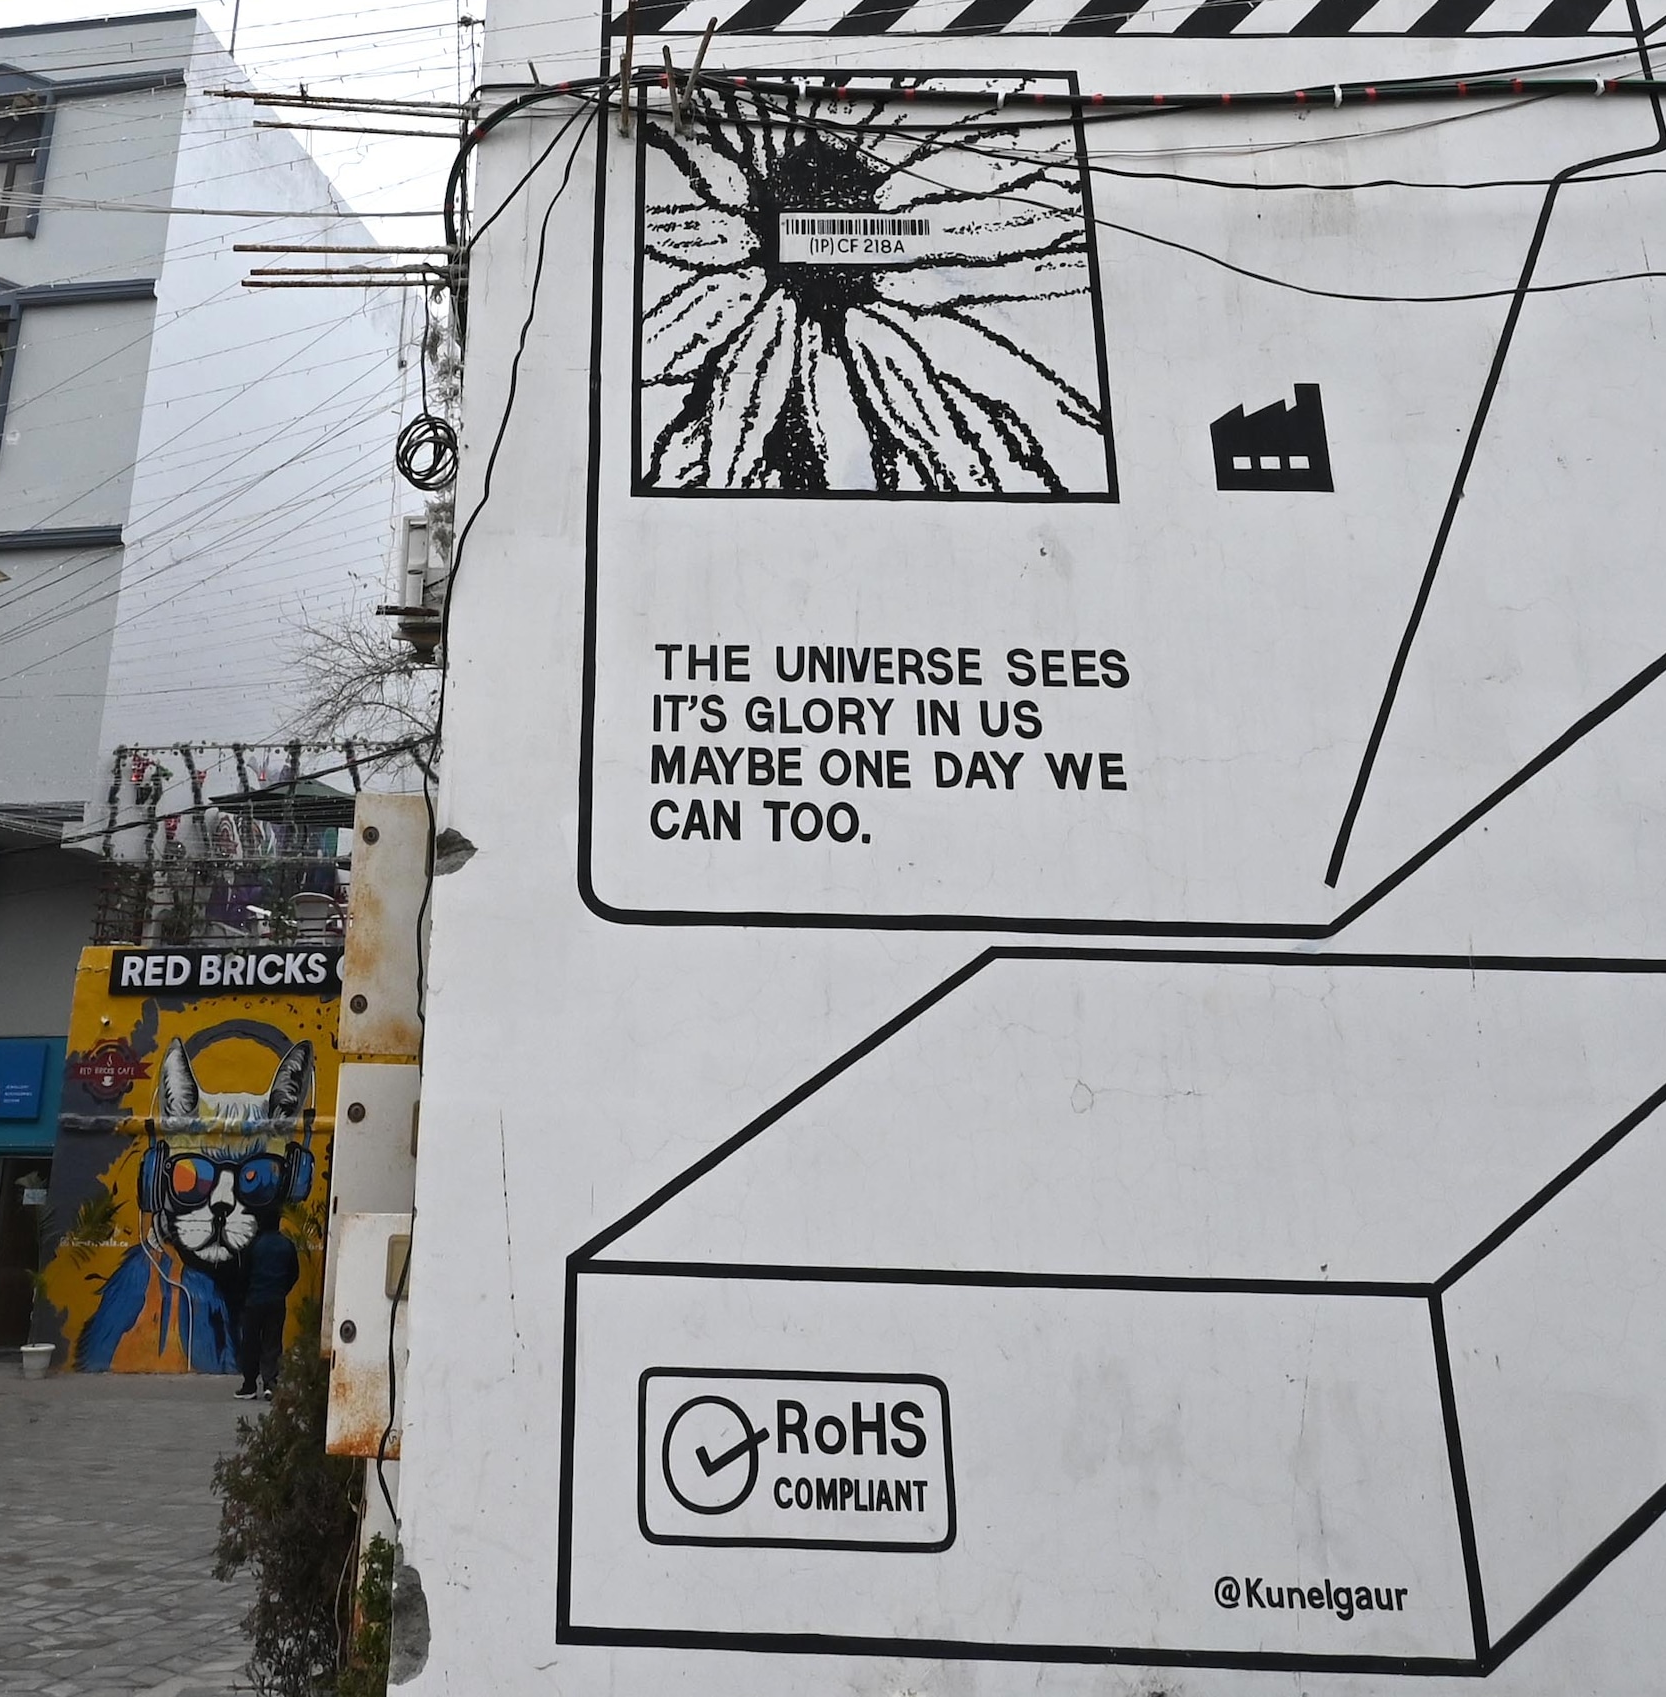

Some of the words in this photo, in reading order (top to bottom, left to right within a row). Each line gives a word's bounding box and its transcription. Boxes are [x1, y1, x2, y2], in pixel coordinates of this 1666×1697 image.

[837, 239, 858, 253] CF
[863, 239, 905, 254] 218A
[654, 643, 750, 682] THE
[776, 646, 983, 686] UNIVERSE
[1006, 648, 1130, 689] SEES
[653, 694, 727, 733] IT'S
[745, 696, 895, 736] GLORY
[916, 699, 960, 736] IN
[979, 700, 1043, 740] US
[651, 744, 803, 787] MAYBE
[819, 748, 911, 789] ONE
[934, 751, 1025, 790] DAY
[1044, 752, 1127, 791] WE
[650, 799, 741, 841] CAN
[763, 800, 871, 844] TOO.
[121, 955, 191, 987] RED
[199, 953, 327, 986] BRICKS
[776, 1399, 927, 1458] RoHS
[773, 1476, 928, 1512] COMPLIANT
[1214, 1576, 1408, 1621] @Kunelgaur
